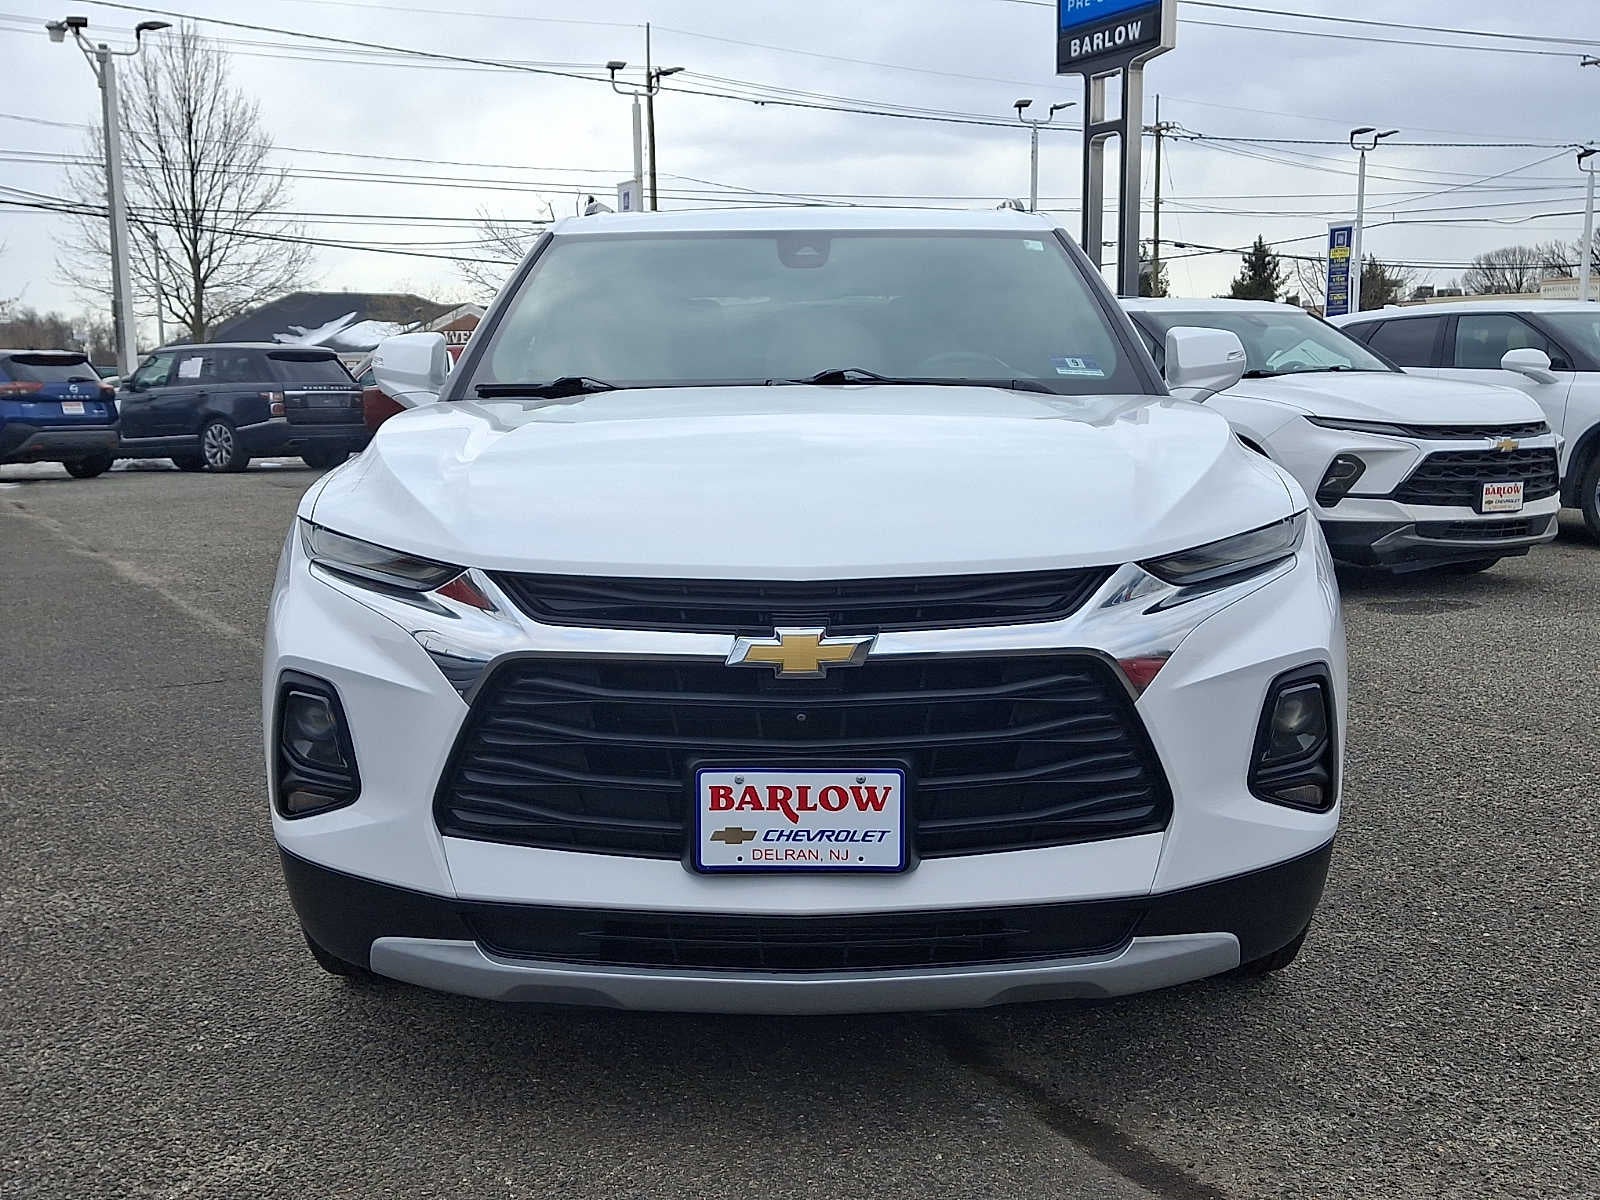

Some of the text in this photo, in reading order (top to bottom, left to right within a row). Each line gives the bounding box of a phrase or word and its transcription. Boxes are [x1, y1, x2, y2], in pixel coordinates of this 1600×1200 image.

[1070, 20, 1142, 58] BARLOW
[1484, 485, 1522, 498] BARLOW
[708, 785, 893, 825] BARLOW
[762, 829, 892, 843] CHEVROLET
[752, 849, 849, 862] DELRAN, NJ
